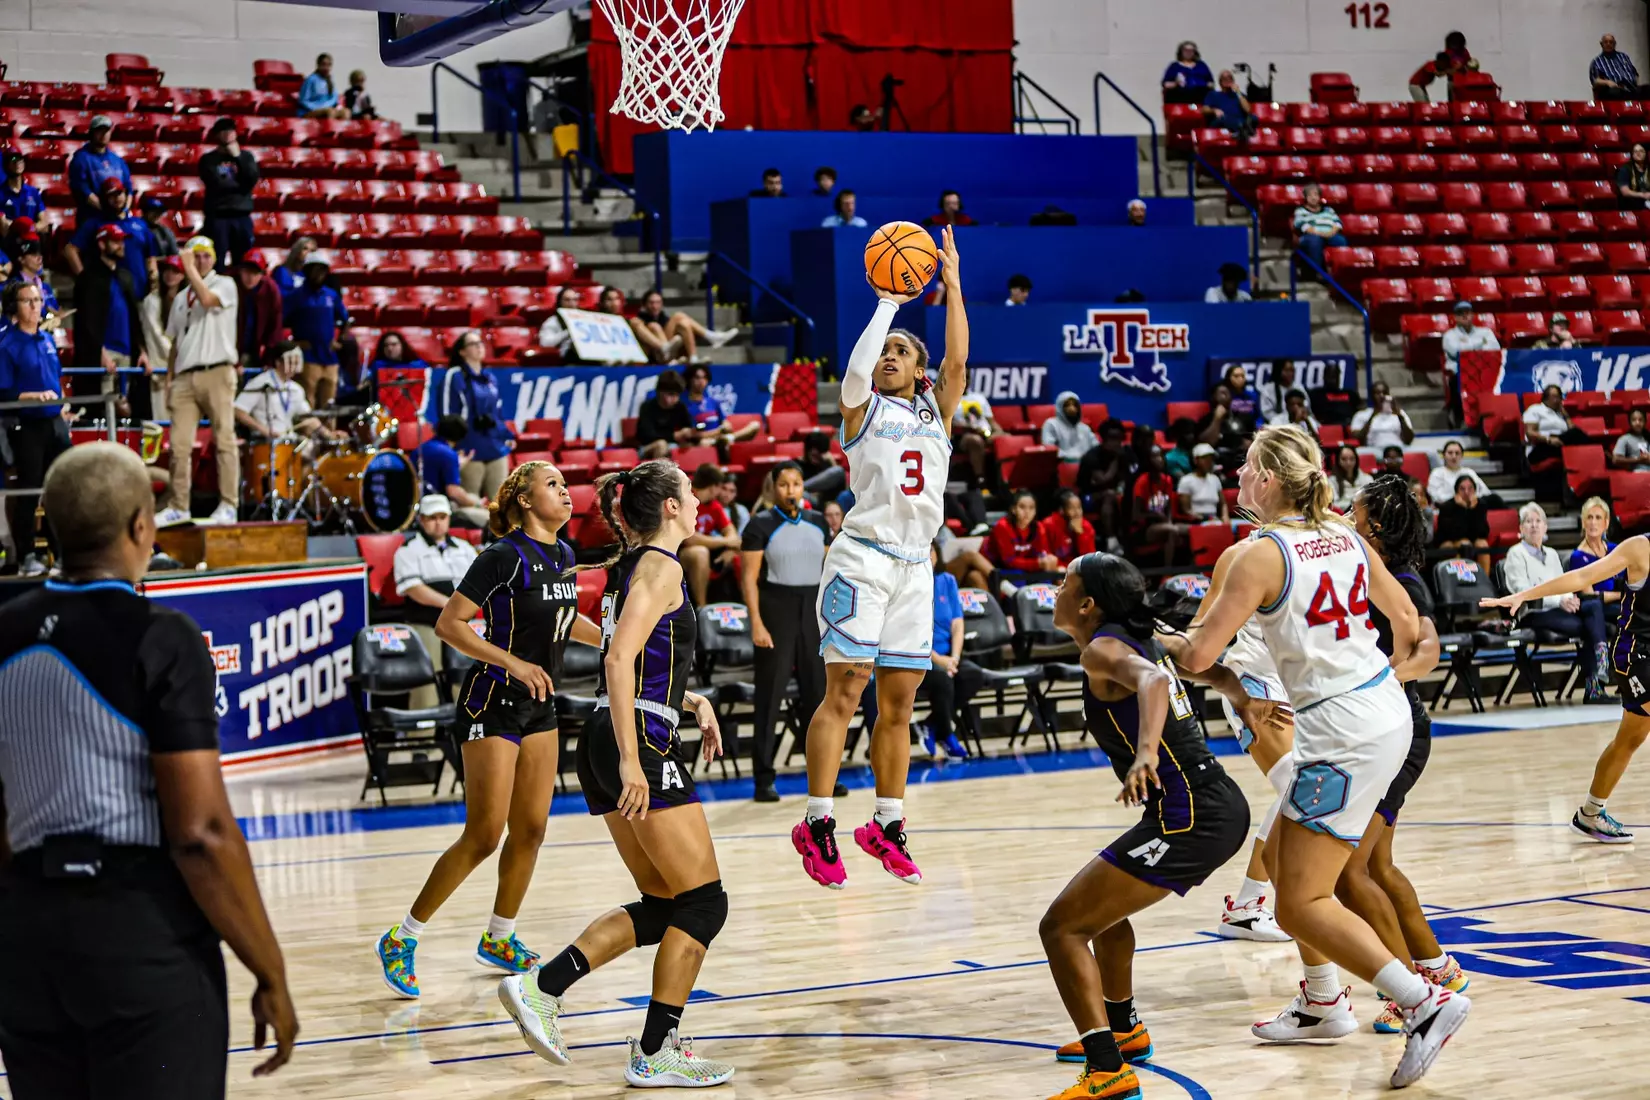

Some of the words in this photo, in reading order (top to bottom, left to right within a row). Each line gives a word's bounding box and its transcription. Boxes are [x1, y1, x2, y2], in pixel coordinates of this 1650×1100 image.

[1344, 2, 1391, 29] 112
[1065, 326, 1102, 352] LA
[1090, 310, 1189, 367] TECH
[1595, 353, 1650, 404] KE
[514, 374, 659, 449] KENNE
[900, 450, 925, 496] 3
[1294, 535, 1355, 562] ROBERSON
[1304, 563, 1375, 641] 44
[250, 589, 344, 676] HOOP
[239, 643, 354, 740] TROOP
